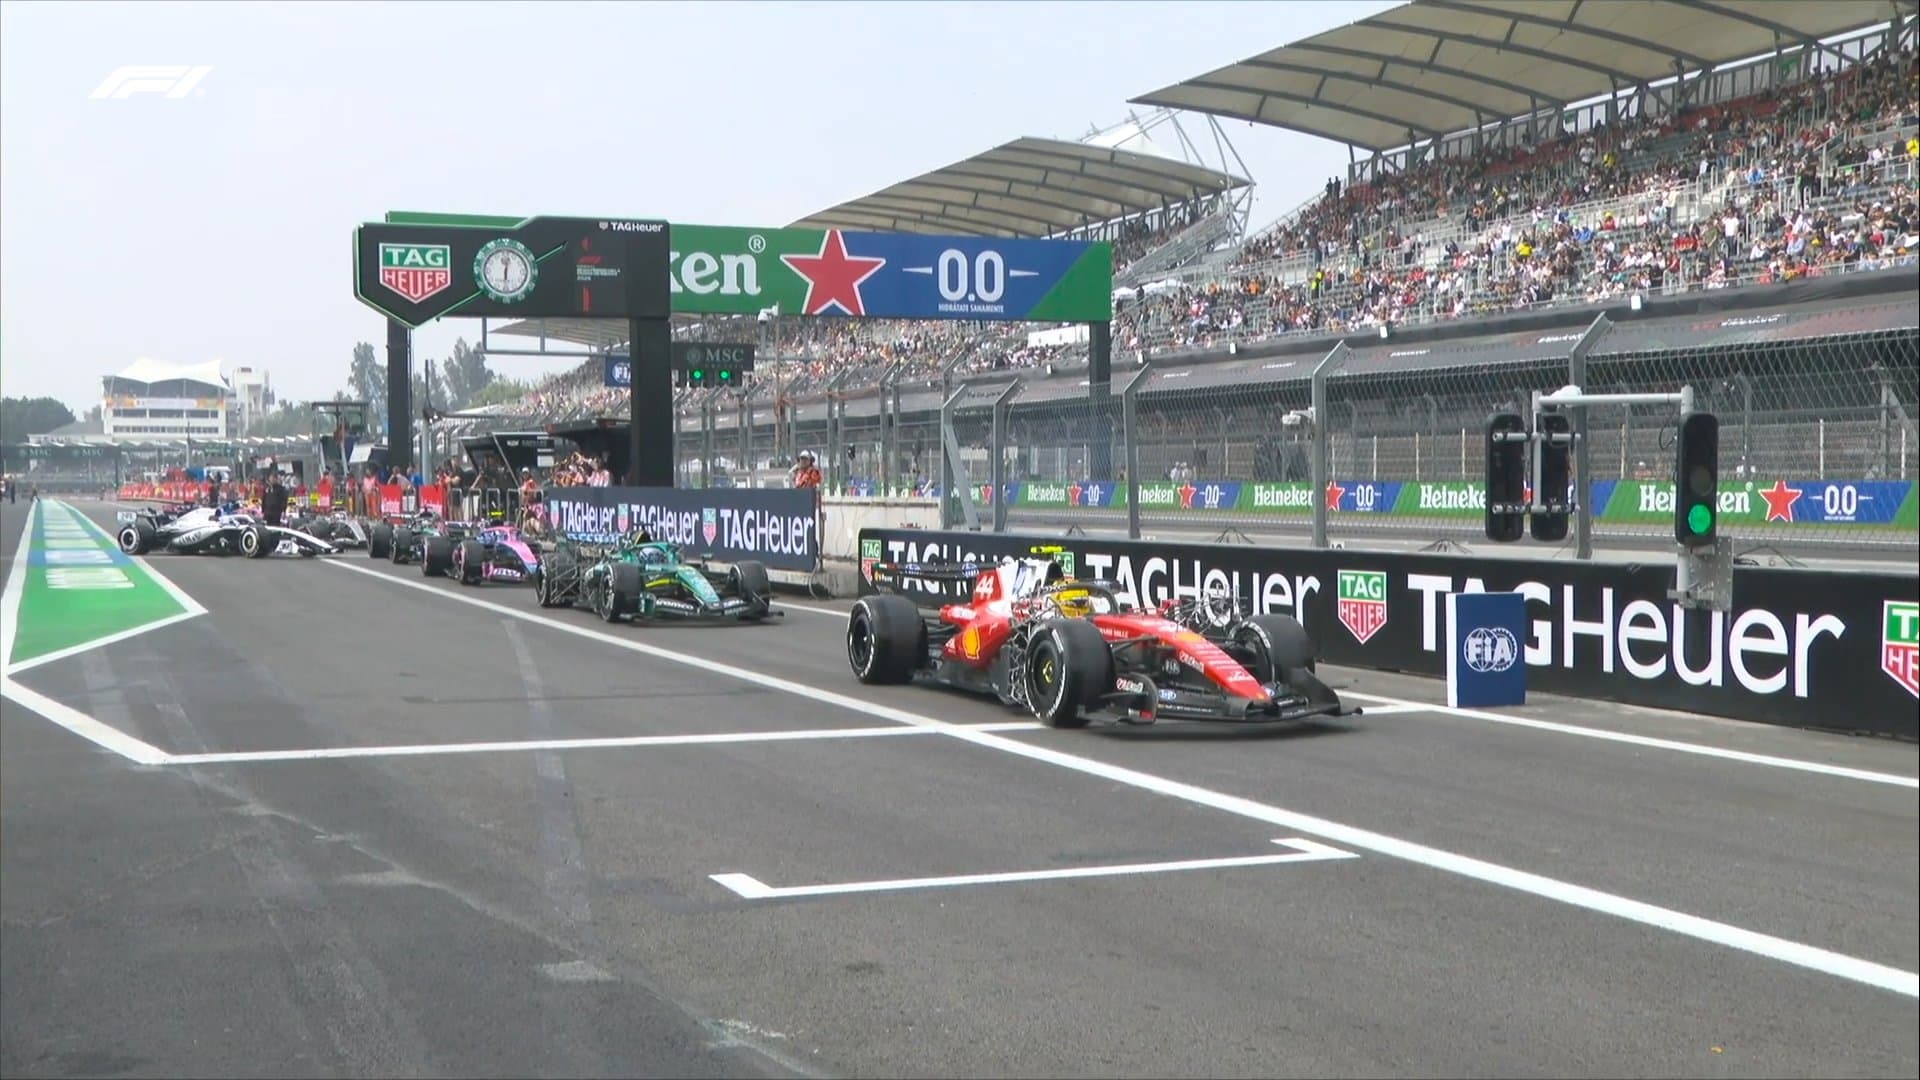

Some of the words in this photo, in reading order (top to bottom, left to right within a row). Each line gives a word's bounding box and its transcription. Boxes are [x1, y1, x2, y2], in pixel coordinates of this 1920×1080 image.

[385, 247, 443, 266] TAG
[384, 270, 446, 298] HEUER
[938, 248, 1004, 302] 0.0
[705, 349, 744, 361] MSC
[1419, 484, 1486, 509] Heineke
[1824, 485, 1857, 515] 0.0
[720, 509, 814, 555] TAGHeuer
[863, 542, 880, 558] TAG
[975, 575, 996, 601] 44
[1341, 575, 1382, 598] TAG
[1341, 602, 1384, 638] HEUER
[1407, 573, 1846, 698] TGHeuer
